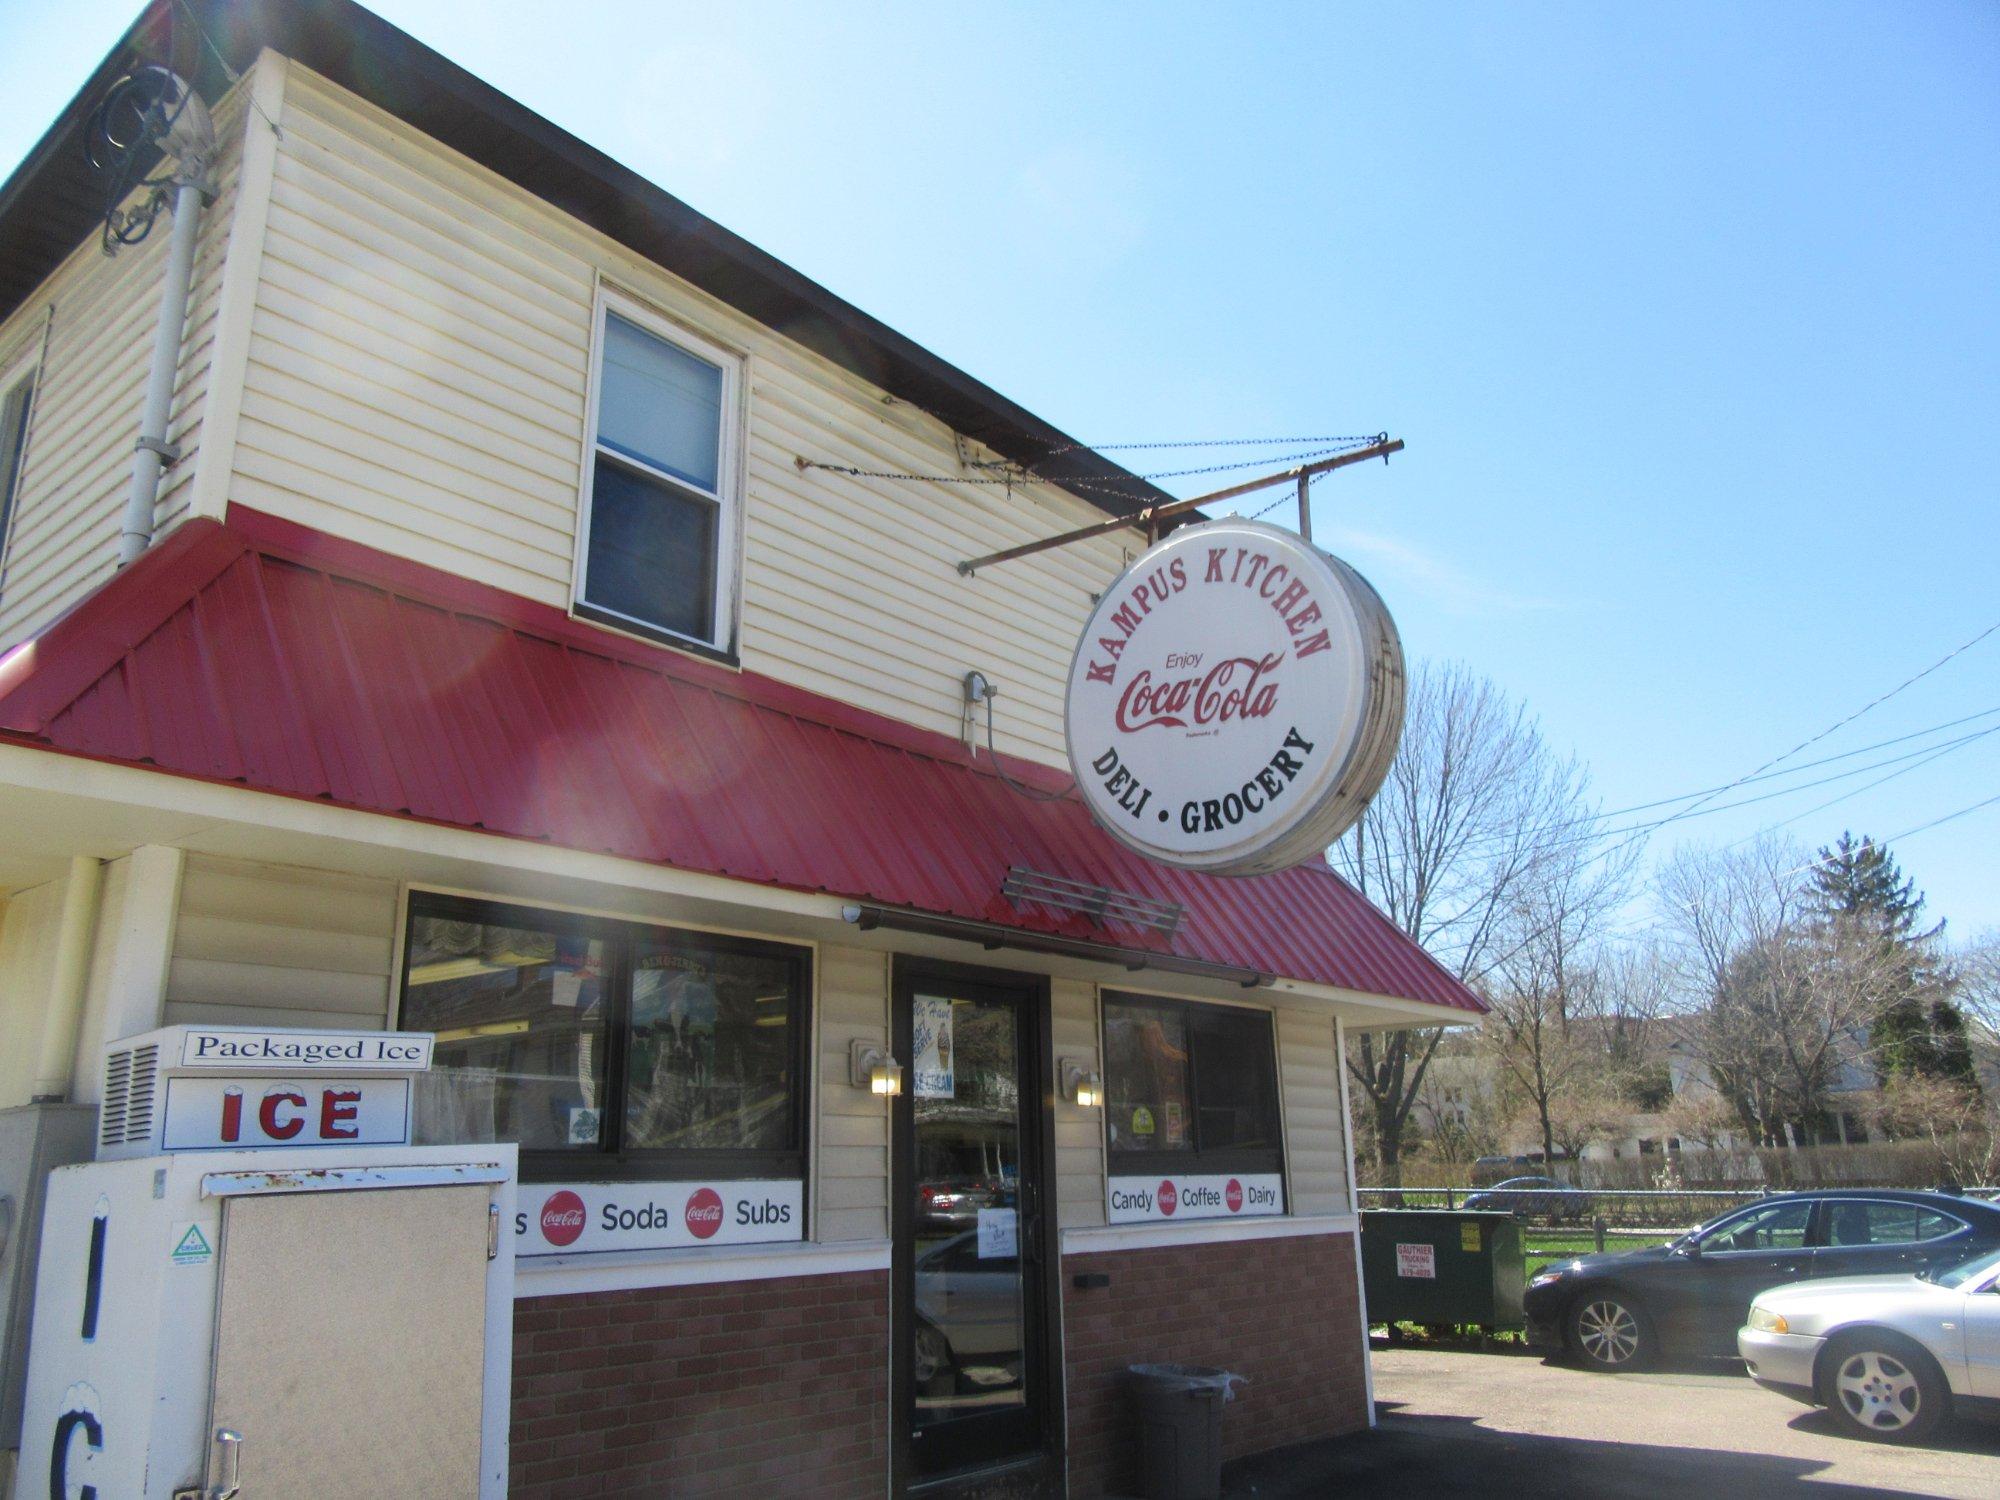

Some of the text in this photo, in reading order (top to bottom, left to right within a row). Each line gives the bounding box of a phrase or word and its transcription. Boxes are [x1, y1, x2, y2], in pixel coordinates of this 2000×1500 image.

[1086, 547, 1332, 686] KAMPUS KITCHEN
[1166, 652, 1203, 669] Enjoy
[1115, 650, 1286, 733] Coca-Cola
[1092, 726, 1315, 834] DELI GROCERY
[195, 1036, 421, 1063] Packaged Ice
[220, 1084, 362, 1142] ICE
[601, 1202, 668, 1231] Soda
[736, 1198, 791, 1225] Subs
[1112, 1190, 1152, 1212] Candy
[1182, 1188, 1220, 1206] Coffee
[1248, 1187, 1276, 1206] Dairy
[1398, 1245, 1433, 1256] GAUTHIER
[1401, 1255, 1430, 1264] TRUCKING
